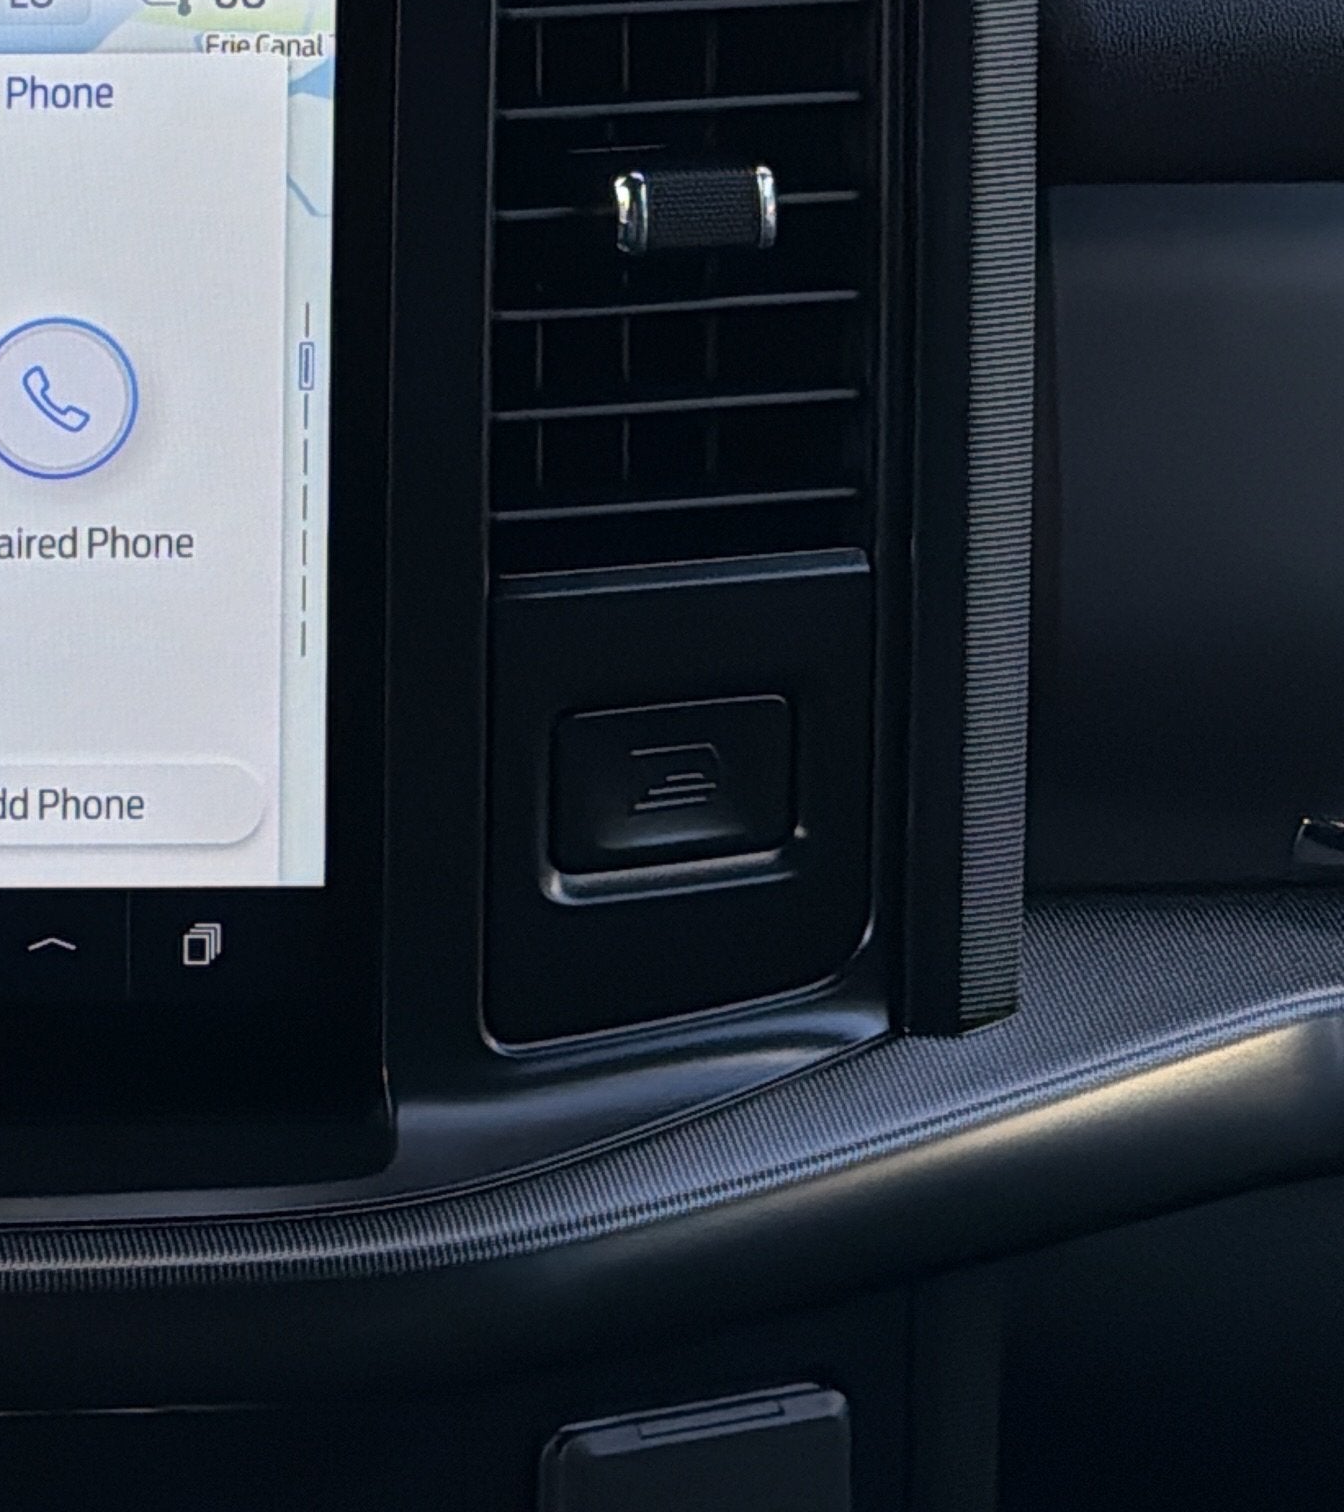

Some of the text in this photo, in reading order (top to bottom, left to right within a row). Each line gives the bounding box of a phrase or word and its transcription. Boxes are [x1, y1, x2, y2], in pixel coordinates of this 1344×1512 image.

[6, 75, 114, 109] Phone
[87, 526, 194, 559] Phone
[38, 787, 145, 820] Phone
